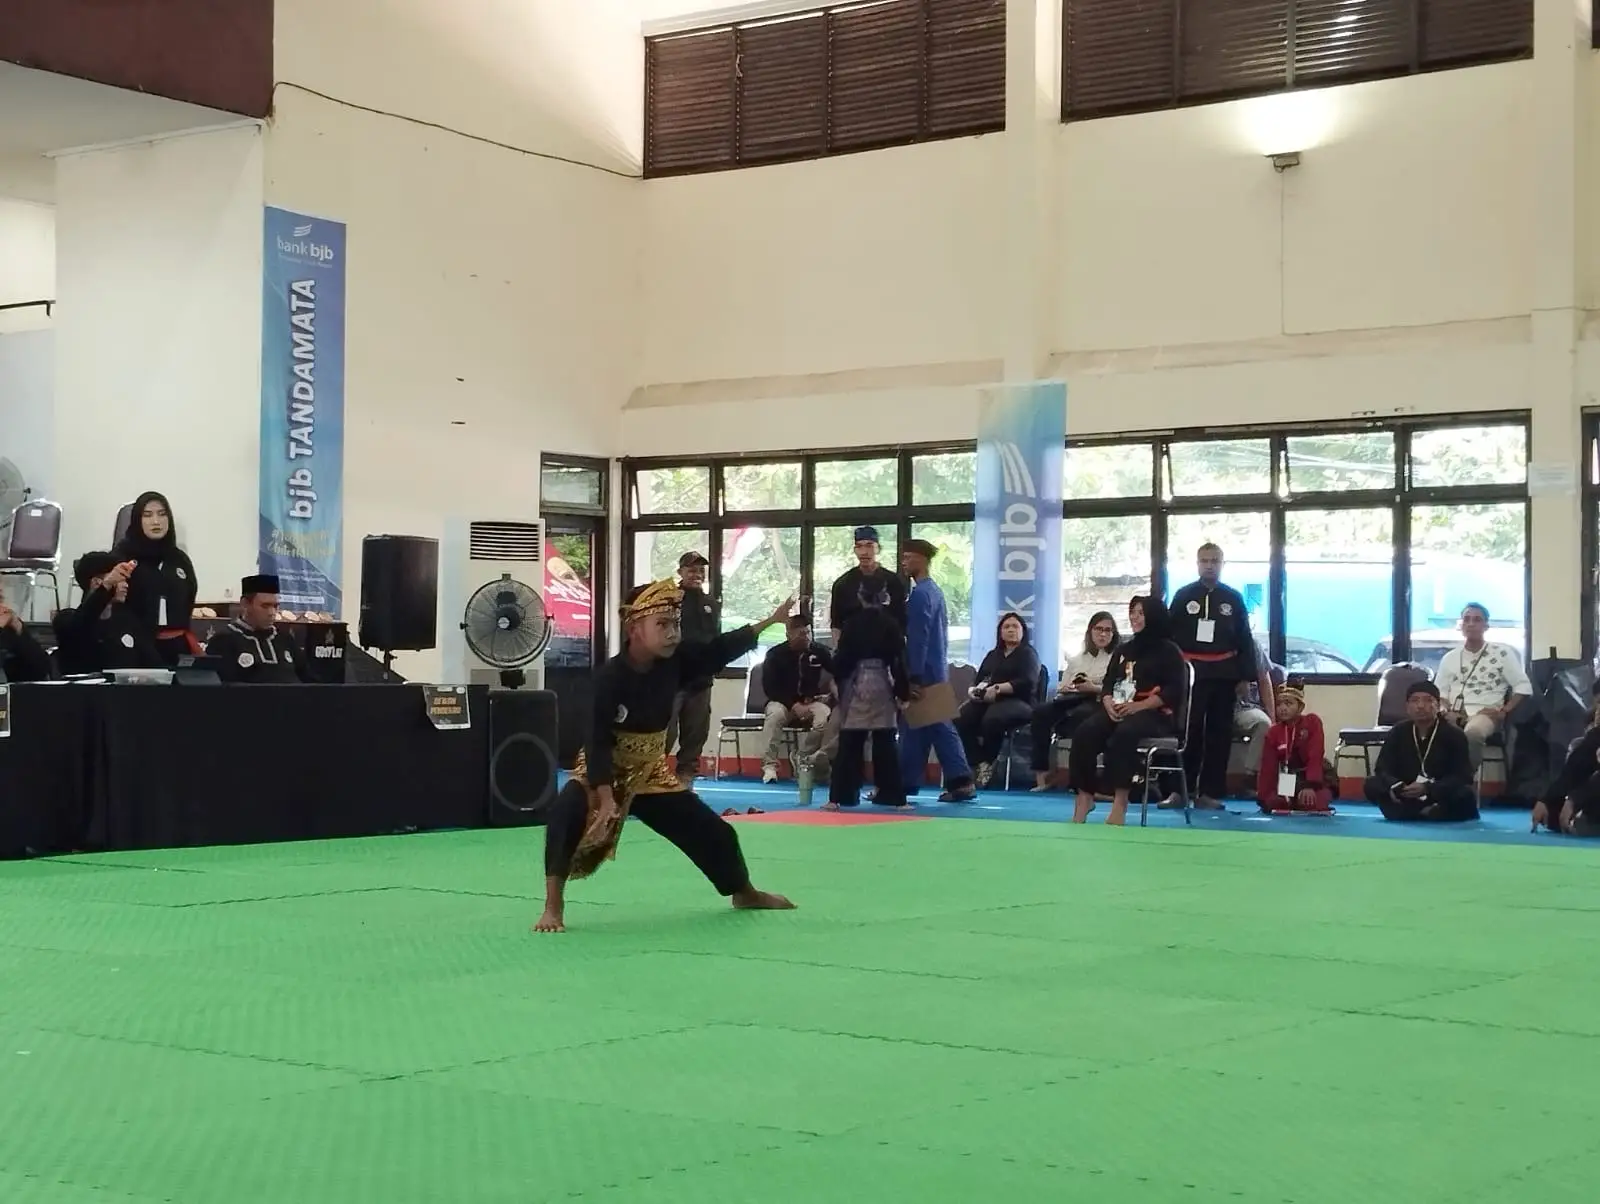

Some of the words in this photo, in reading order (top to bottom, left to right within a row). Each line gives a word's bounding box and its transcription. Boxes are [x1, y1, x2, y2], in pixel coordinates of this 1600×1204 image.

[276, 234, 309, 254] bank
[310, 242, 334, 261] bjb
[289, 279, 315, 459] TANDAMATA
[288, 468, 317, 519] bjb
[999, 502, 1047, 581] bjb
